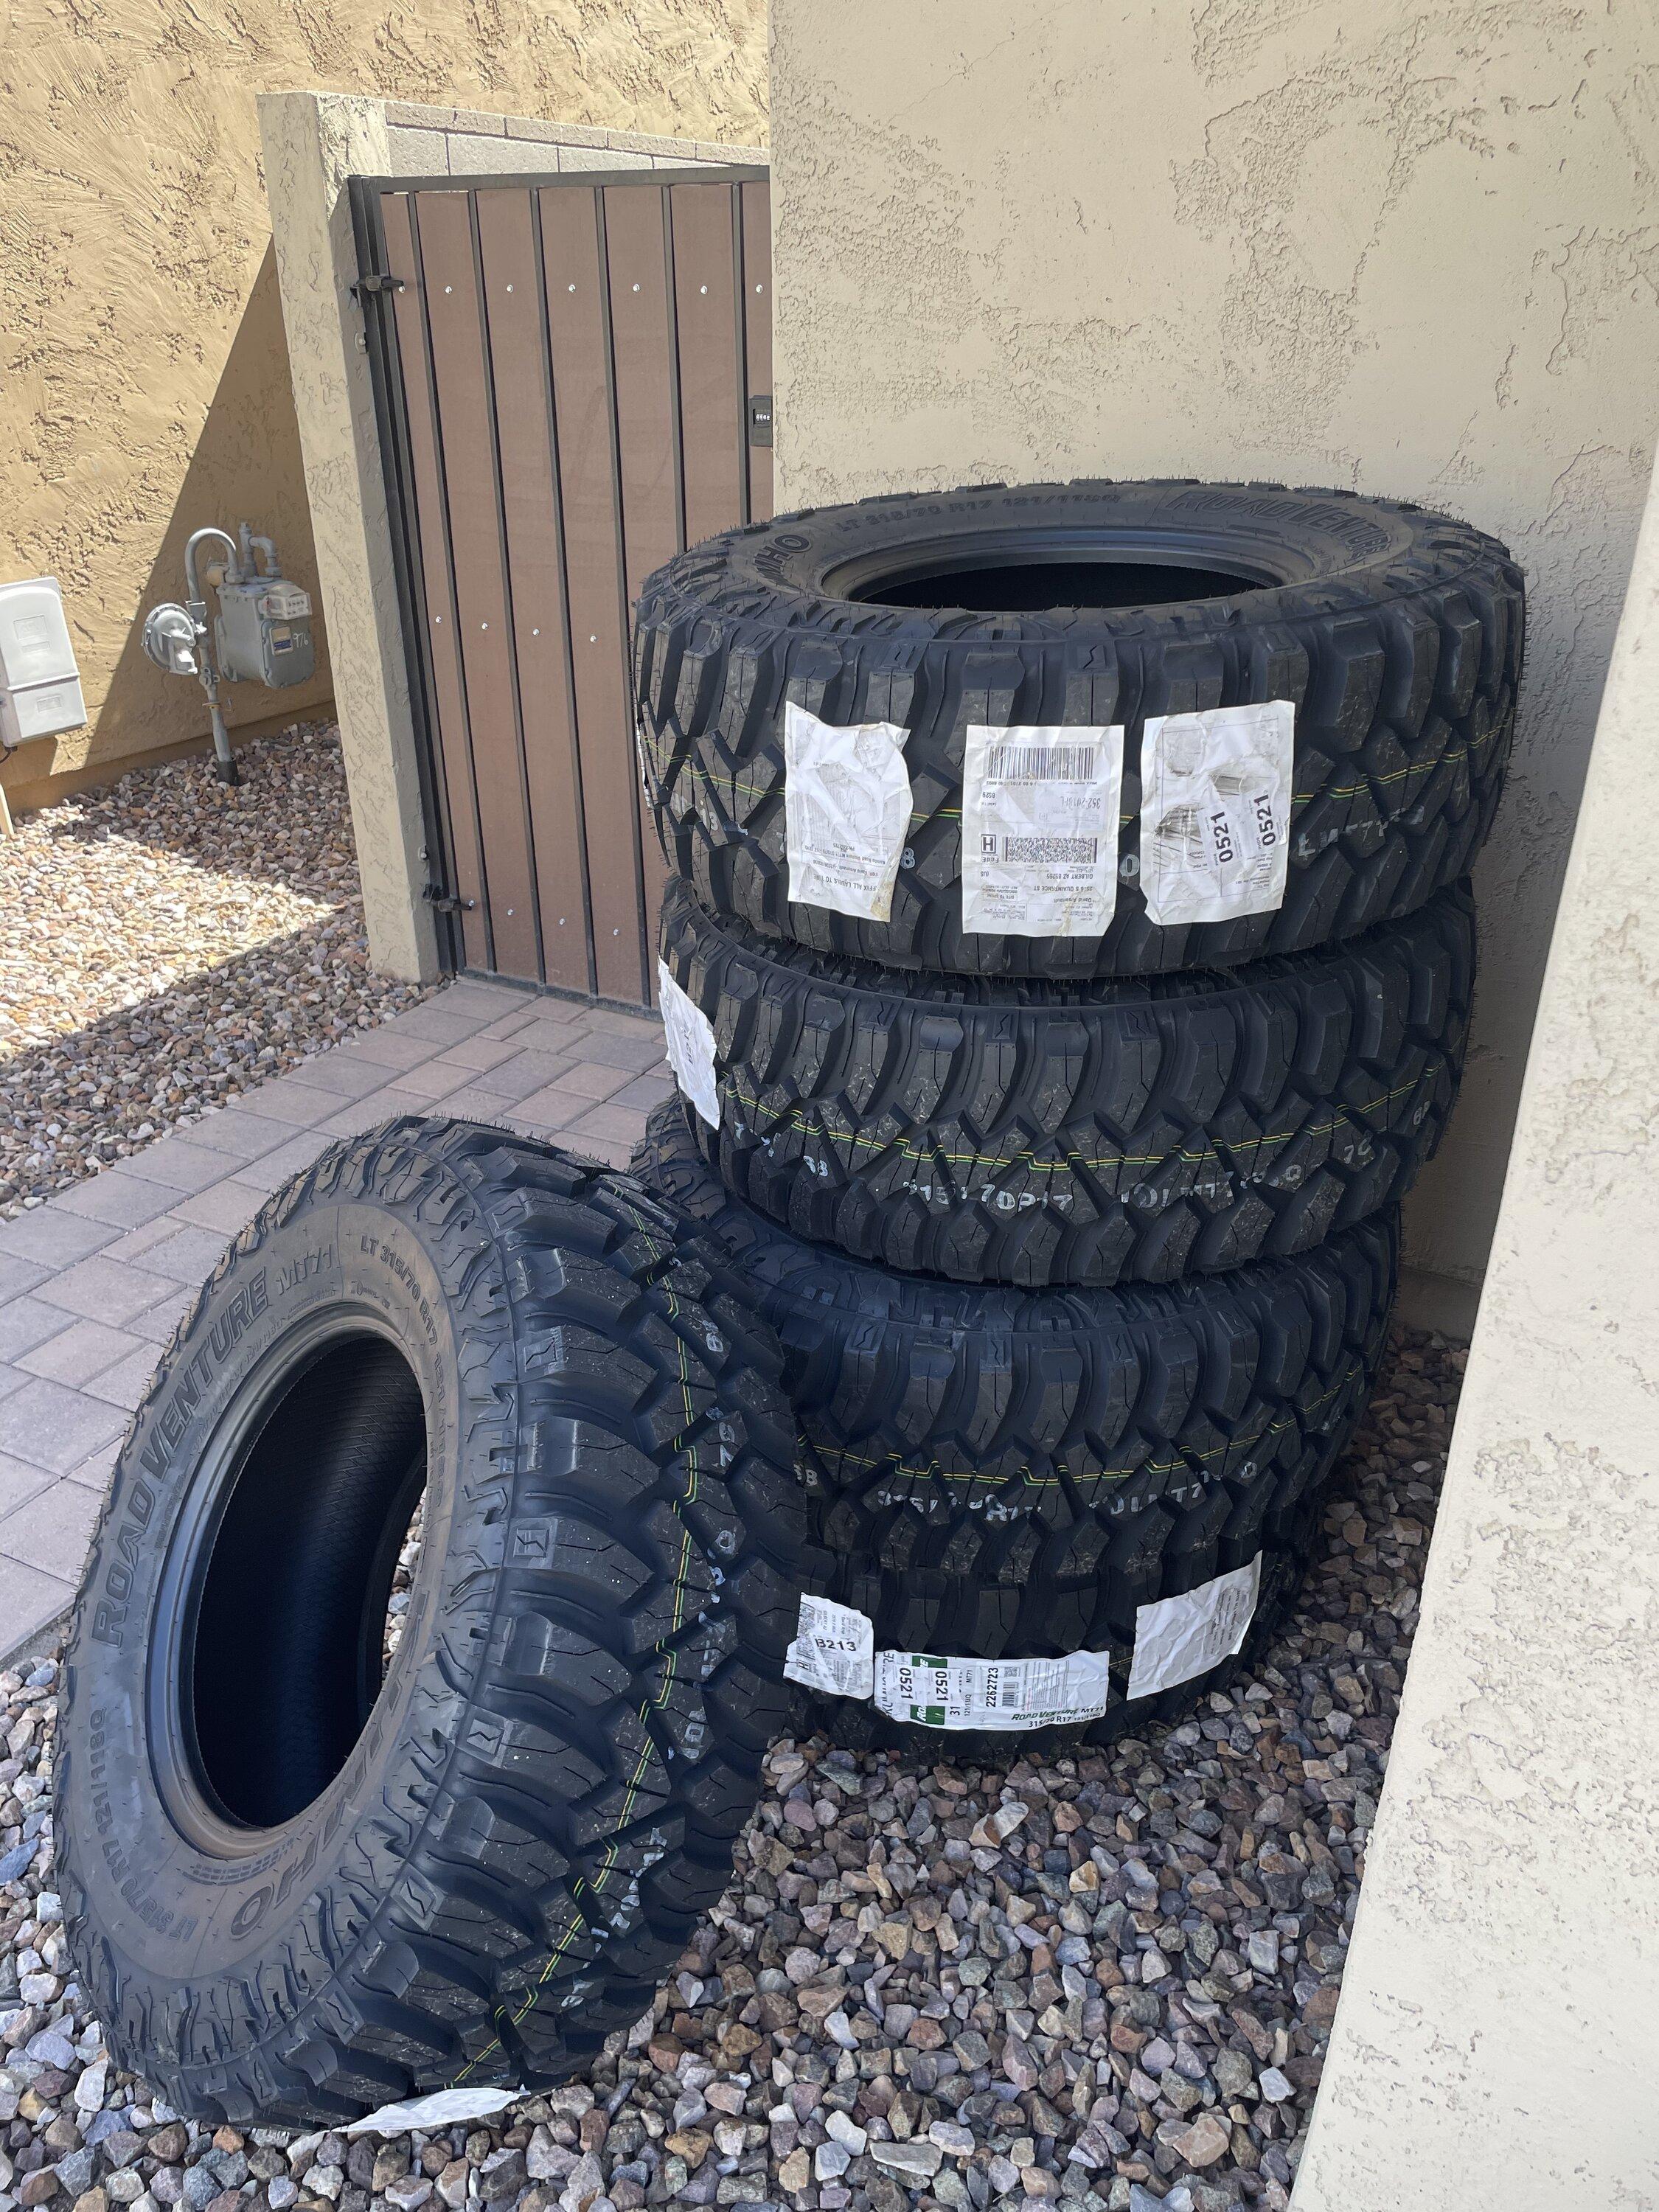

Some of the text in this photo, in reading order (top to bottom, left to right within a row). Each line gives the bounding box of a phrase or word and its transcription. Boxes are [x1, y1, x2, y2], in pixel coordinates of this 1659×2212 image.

[948, 499, 992, 514] R17
[292, 632, 309, 649] 976
[1253, 794, 1277, 847] 0521
[983, 837, 994, 851] H
[1210, 812, 1234, 863] 0521
[863, 883, 877, 891] FFIX
[360, 1234, 380, 1256] LT
[379, 1244, 421, 1303] 315/70
[418, 1297, 439, 1346] R17
[814, 1638, 857, 1652] B213
[899, 1667, 914, 1700] 0521
[935, 1671, 949, 1702] 0521
[985, 1666, 999, 1708] 2262723
[1028, 1717, 1055, 1728] 315/70
[1056, 1715, 1072, 1723] R17
[88, 1706, 114, 1835] 121/118Q
[119, 1875, 175, 1934] 315/70
[168, 1913, 199, 1942] LT
